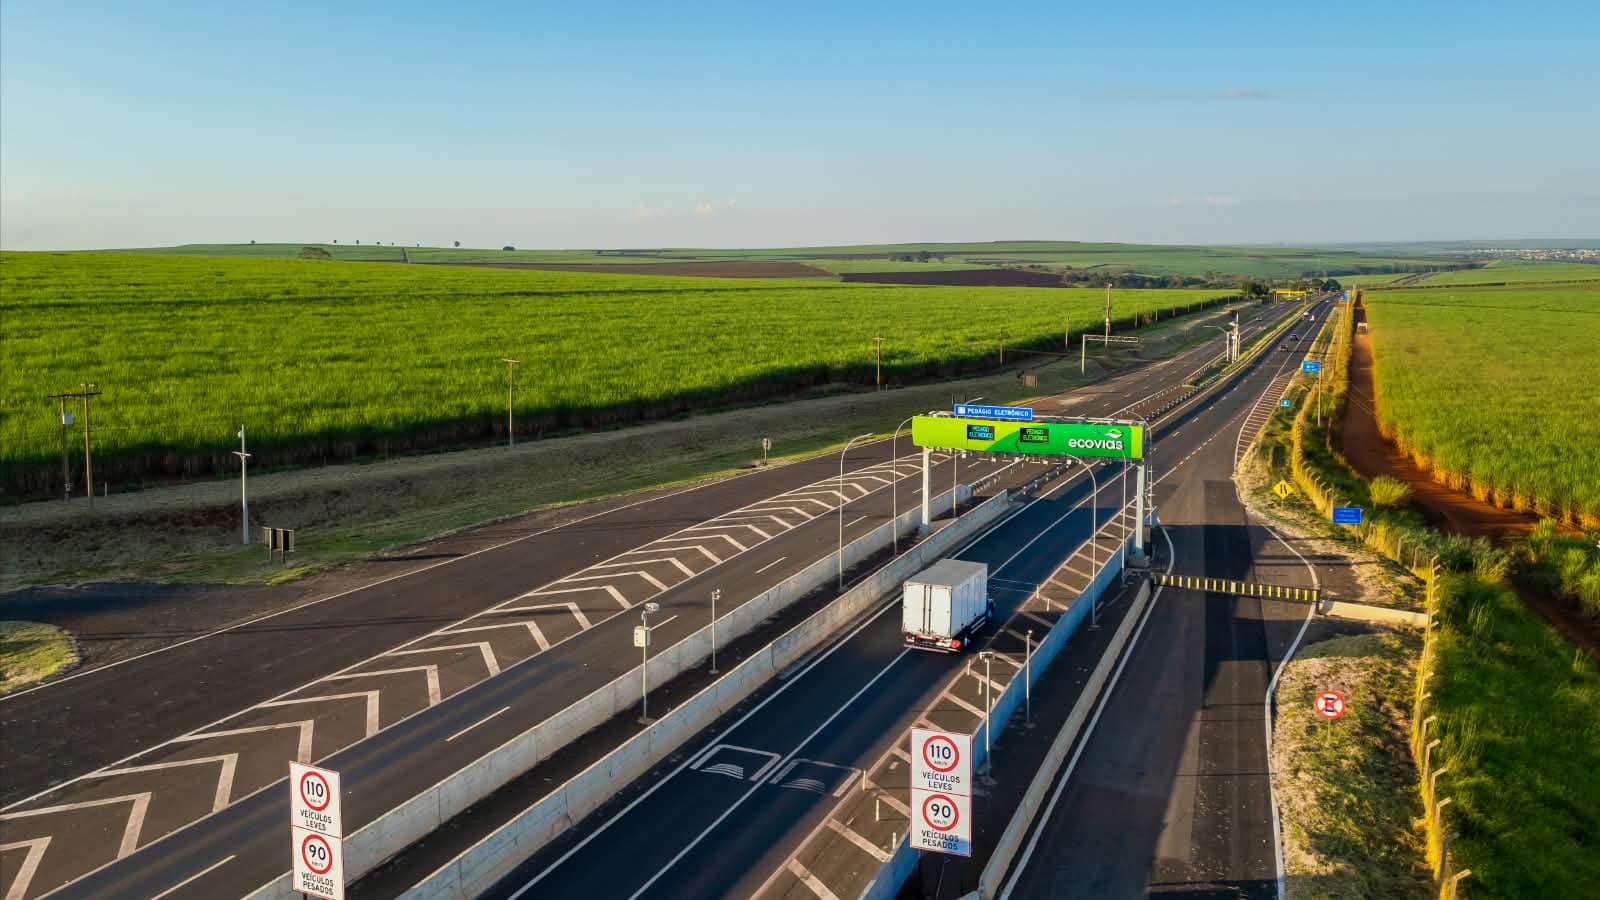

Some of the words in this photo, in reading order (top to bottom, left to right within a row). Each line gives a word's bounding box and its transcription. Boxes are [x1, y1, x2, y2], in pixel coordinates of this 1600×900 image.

[1068, 438, 1123, 450] ecovias
[930, 744, 951, 760] 110
[922, 770, 960, 784] VEÍCULOS
[306, 780, 324, 798] 110
[928, 780, 952, 790] LEVES
[300, 808, 332, 824] VEÍCULOS
[930, 804, 951, 818] 90
[306, 820, 326, 831] LEVES
[922, 838, 958, 850] PESADOS
[309, 844, 326, 860] 90
[302, 880, 334, 896] PESADOS
